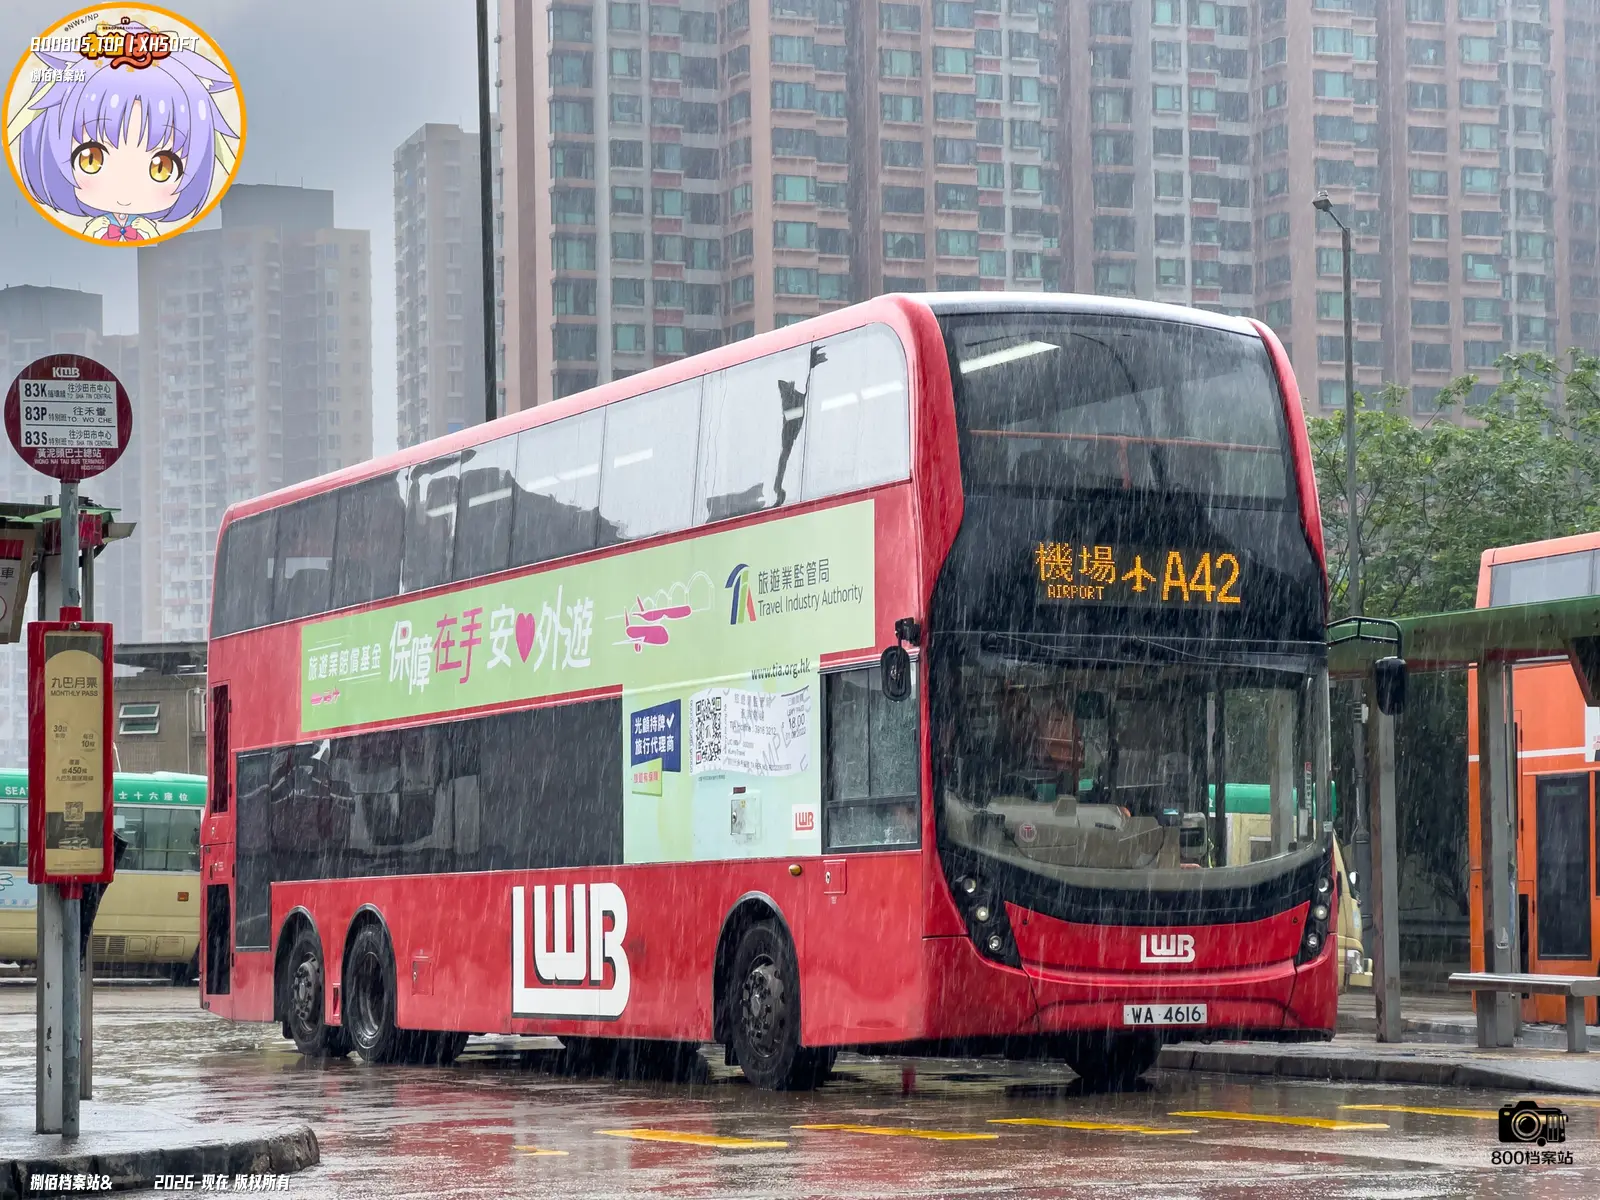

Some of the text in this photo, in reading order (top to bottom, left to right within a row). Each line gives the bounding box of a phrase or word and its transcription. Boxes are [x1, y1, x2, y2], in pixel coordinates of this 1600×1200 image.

[52, 366, 81, 378] KMB
[24, 382, 48, 398] 83K
[67, 383, 111, 393] 往沙田市中心
[25, 406, 47, 421] 83P
[25, 431, 48, 446] 83S
[69, 430, 112, 440] 往沙田市中心
[758, 558, 830, 595] 旅遊業監管局
[1035, 541, 1241, 603] 機場 A42
[758, 583, 864, 616] Travel Industry Authority
[1047, 584, 1105, 600] AIRPORT
[751, 658, 811, 681] www.tia.org.hk
[634, 713, 666, 734] 光顧持牌
[634, 734, 675, 755] 旅行代理商
[5, 786, 28, 796] SEA
[795, 811, 815, 831] LWB
[511, 882, 631, 1021] LWB
[1140, 934, 1196, 963] LWB
[1131, 1006, 1202, 1023] WA 4616
